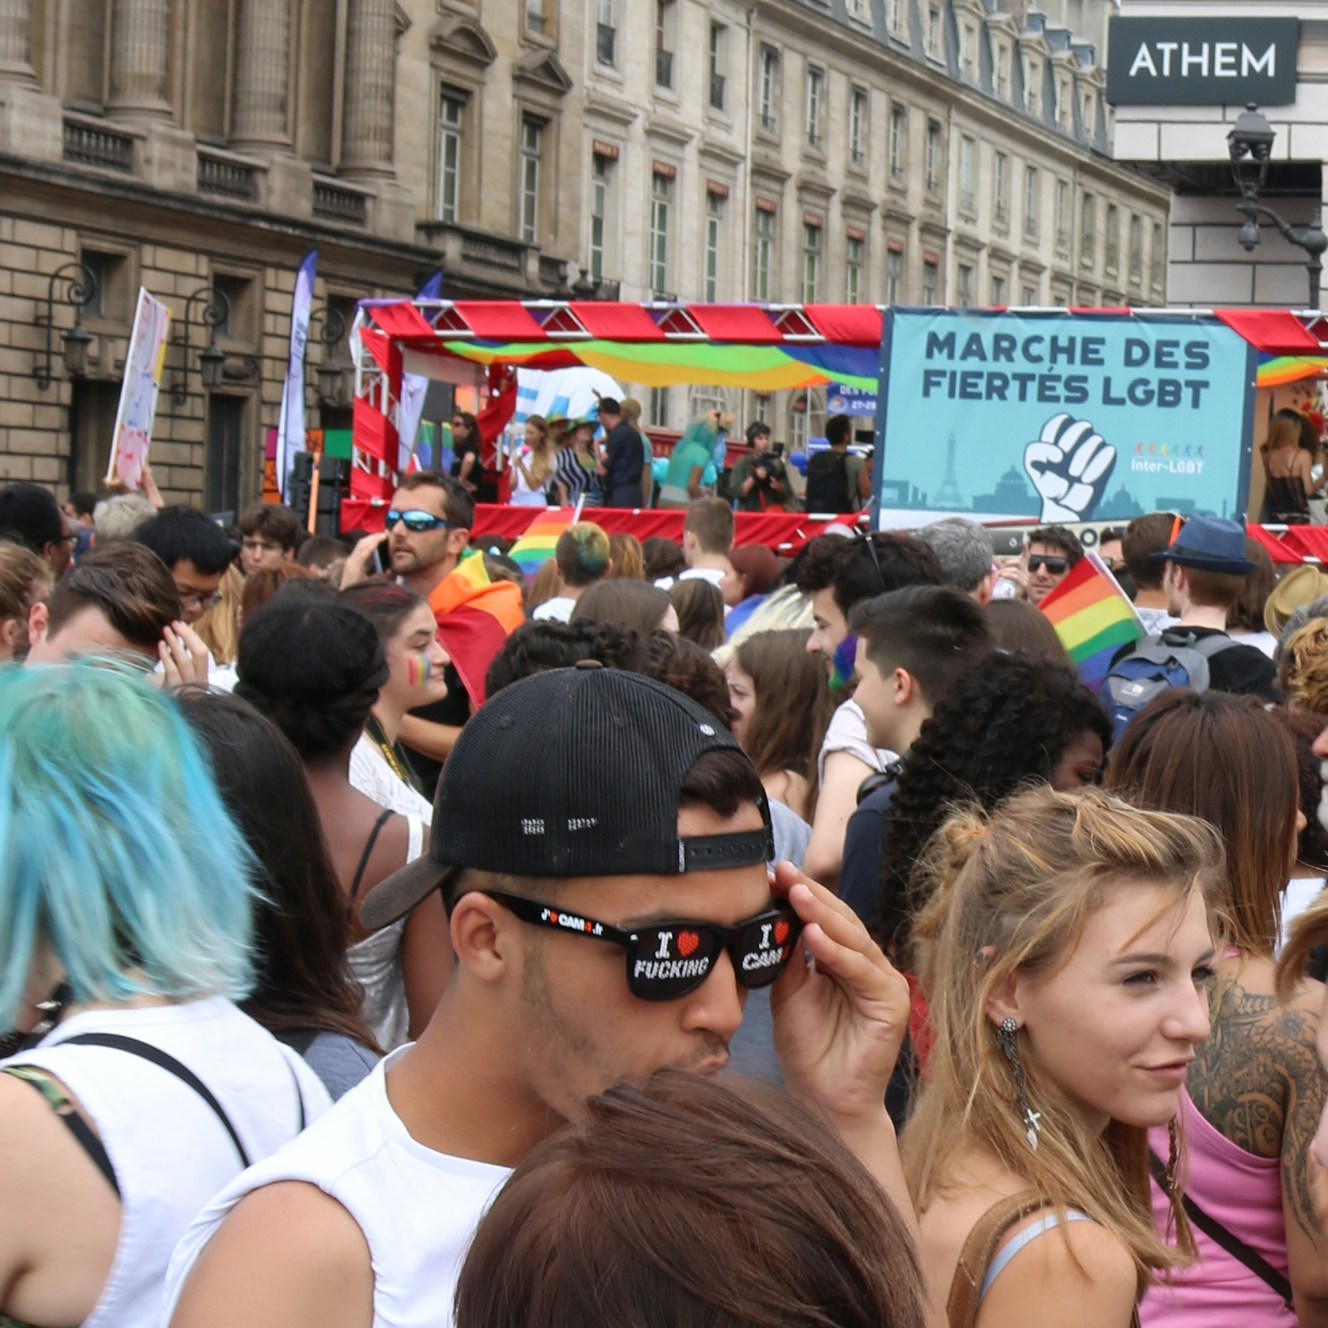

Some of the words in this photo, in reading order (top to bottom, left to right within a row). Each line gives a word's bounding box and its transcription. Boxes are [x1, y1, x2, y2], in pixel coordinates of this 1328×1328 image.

[1129, 42, 1276, 77] ATHEM
[925, 330, 1106, 366] MARCHE
[1123, 337, 1211, 370] DES
[922, 366, 1089, 404] FIERTÉS
[1102, 375, 1210, 410] LGBT
[1131, 458, 1204, 474] Inter-LGBT
[655, 931, 673, 959] I
[758, 923, 772, 950] I
[634, 957, 709, 979] FUCKING
